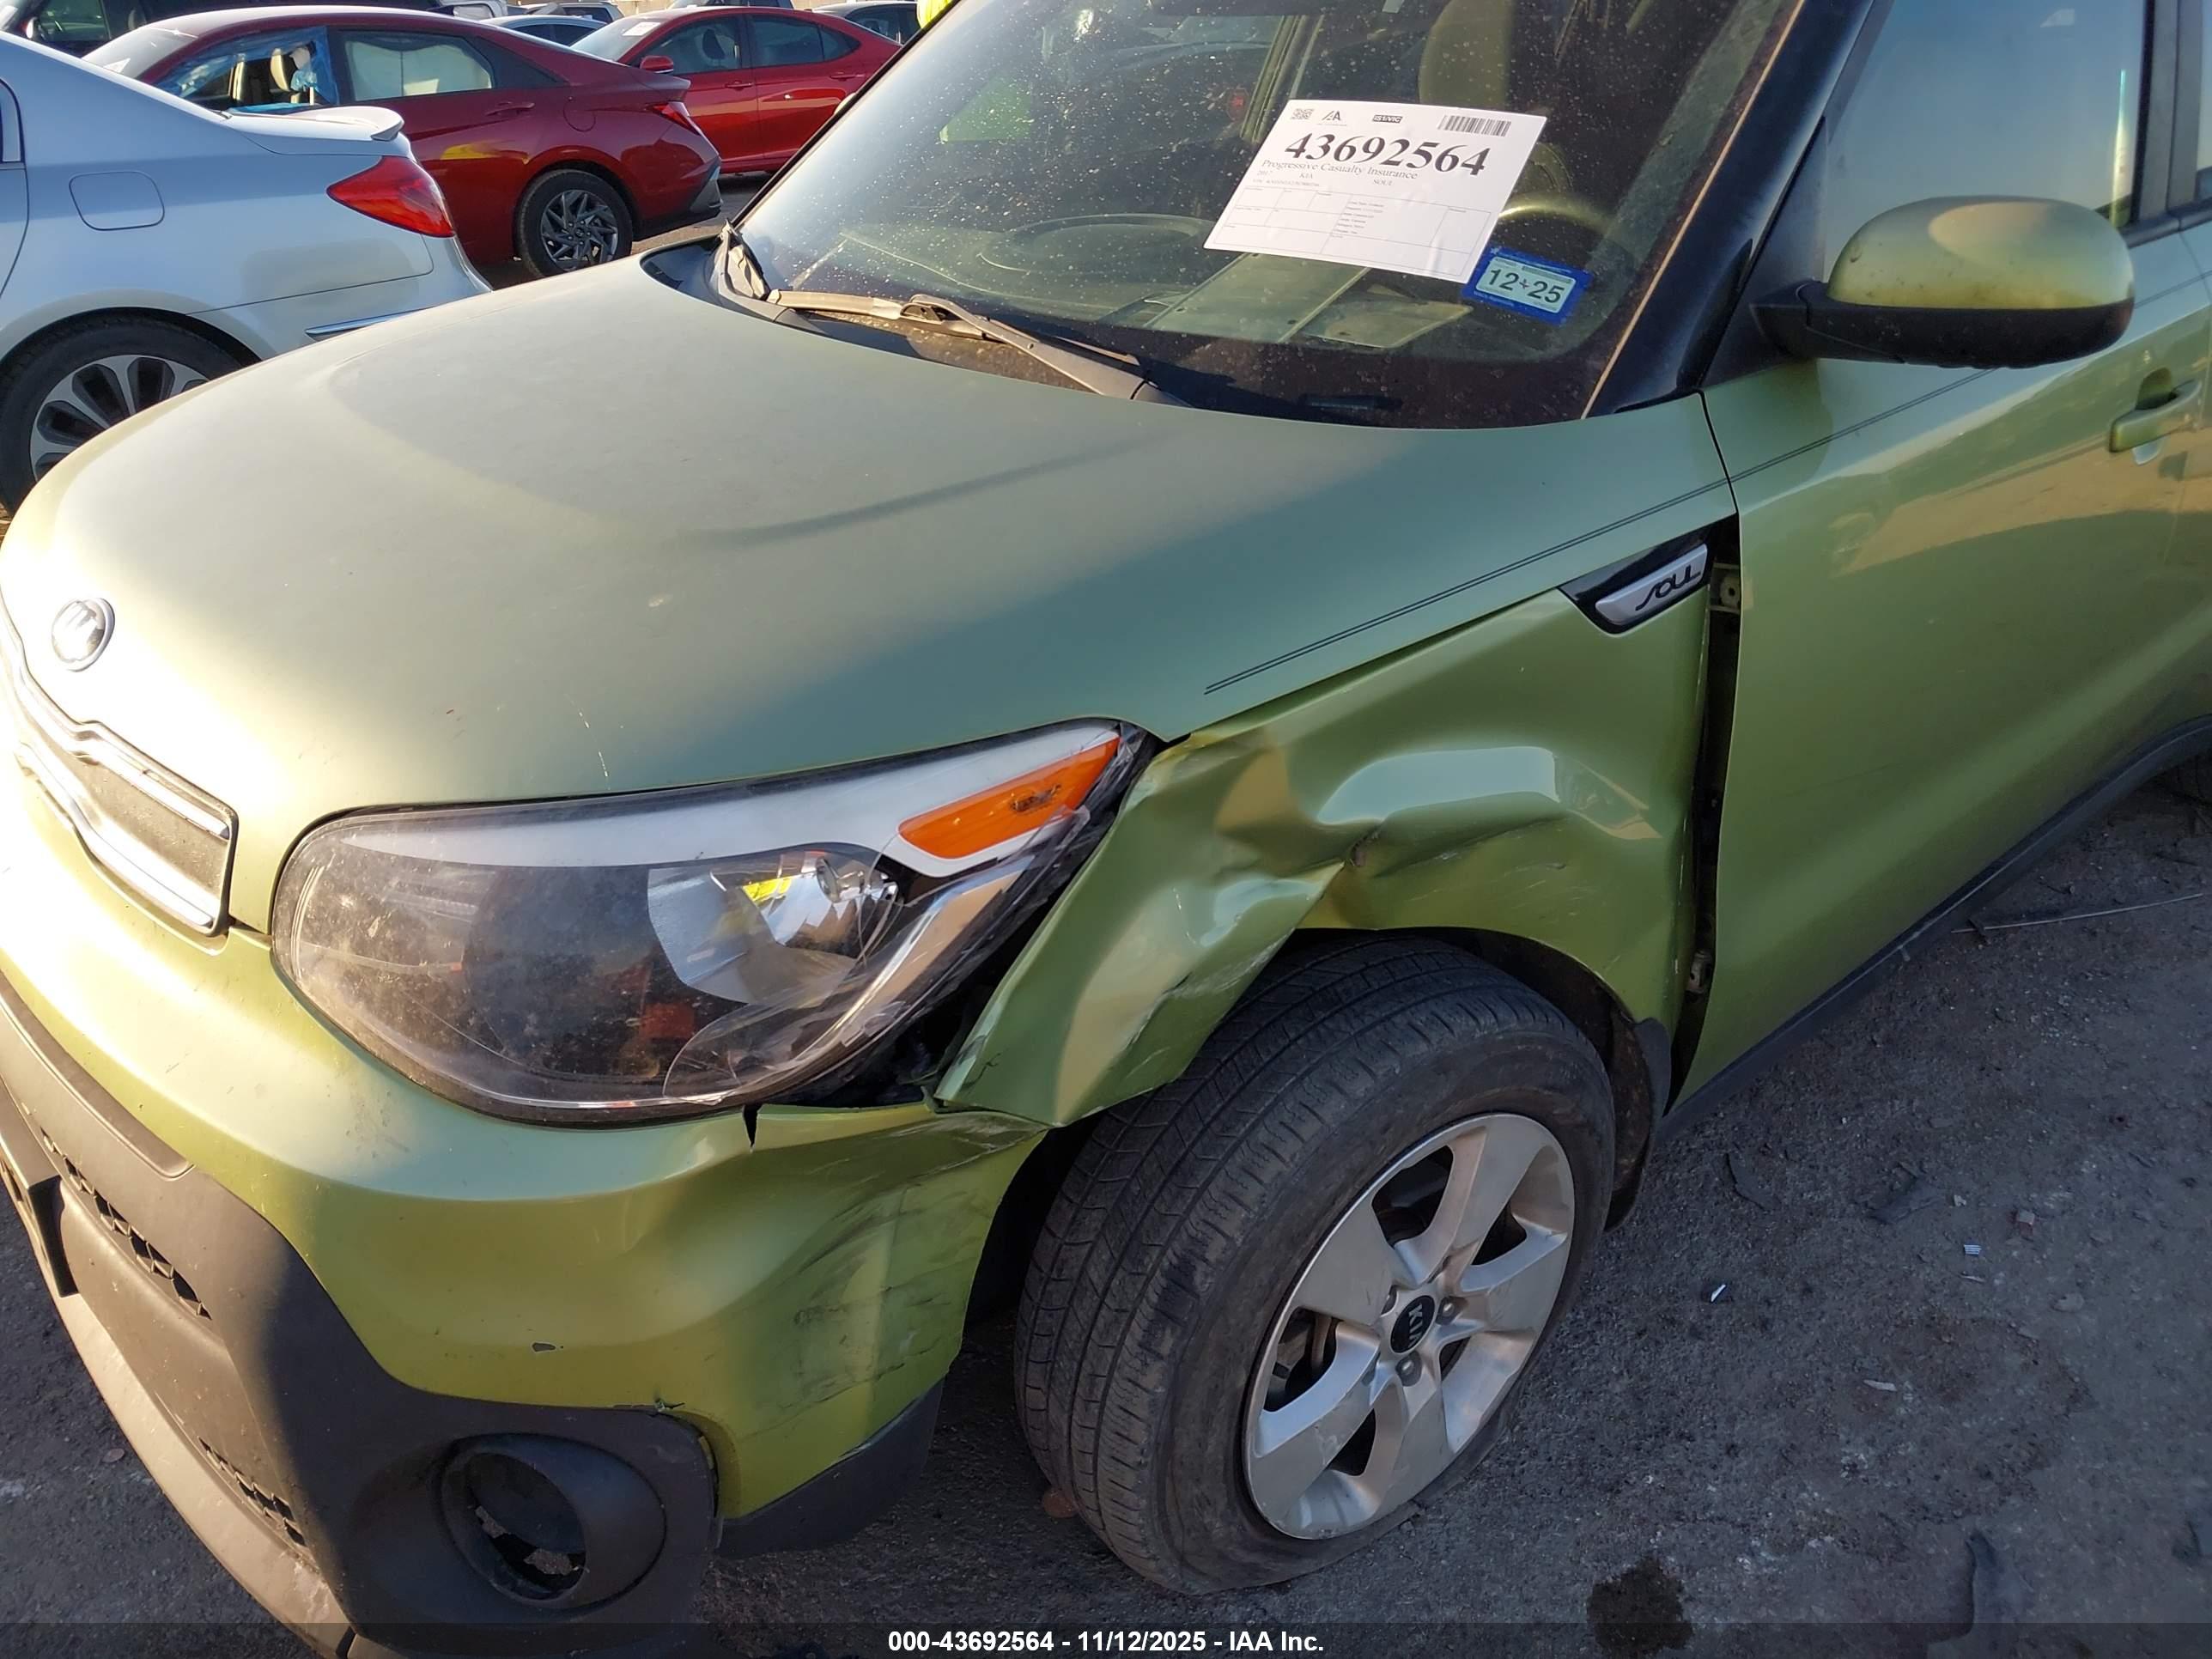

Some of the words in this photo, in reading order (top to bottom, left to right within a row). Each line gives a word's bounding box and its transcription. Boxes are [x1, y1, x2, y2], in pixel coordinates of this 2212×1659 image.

[1261, 160, 1319, 170] Progressive
[1321, 163, 1363, 175] Casualty
[1367, 167, 1418, 179] Insurance
[1285, 132, 1491, 175] 43692564
[1490, 269, 1520, 291] 12
[1527, 281, 1565, 303] 25
[1635, 564, 1701, 611] SOUL
[1408, 1304, 1423, 1348] KIA
